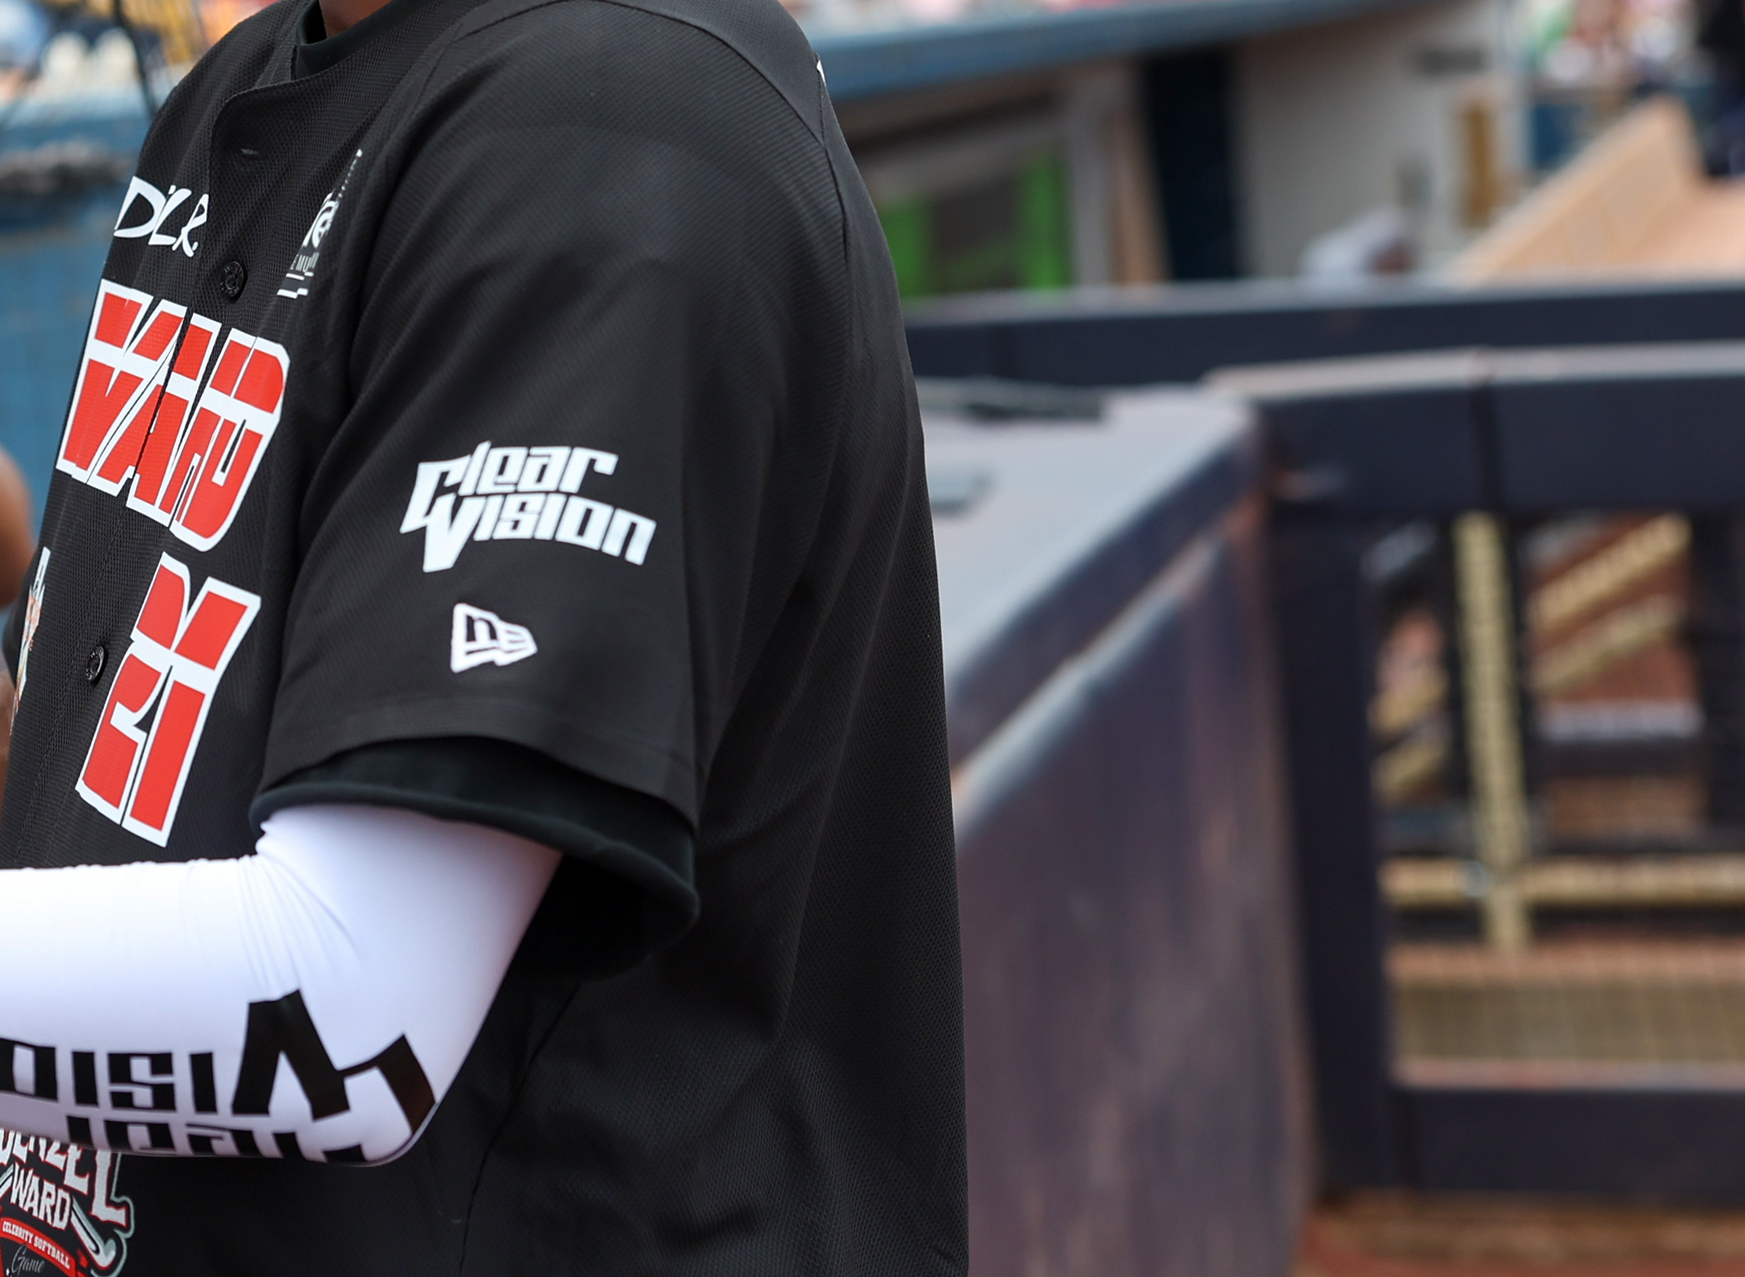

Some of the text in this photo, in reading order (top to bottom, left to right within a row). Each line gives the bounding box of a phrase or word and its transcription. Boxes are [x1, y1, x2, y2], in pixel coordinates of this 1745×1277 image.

[399, 440, 619, 534] Clear
[422, 491, 657, 573] Vision
[74, 550, 262, 848] 21
[10, 1162, 71, 1231] WARD
[2, 1220, 71, 1270] CELEBRITY SOFTBALL
[11, 1244, 45, 1276] Game
